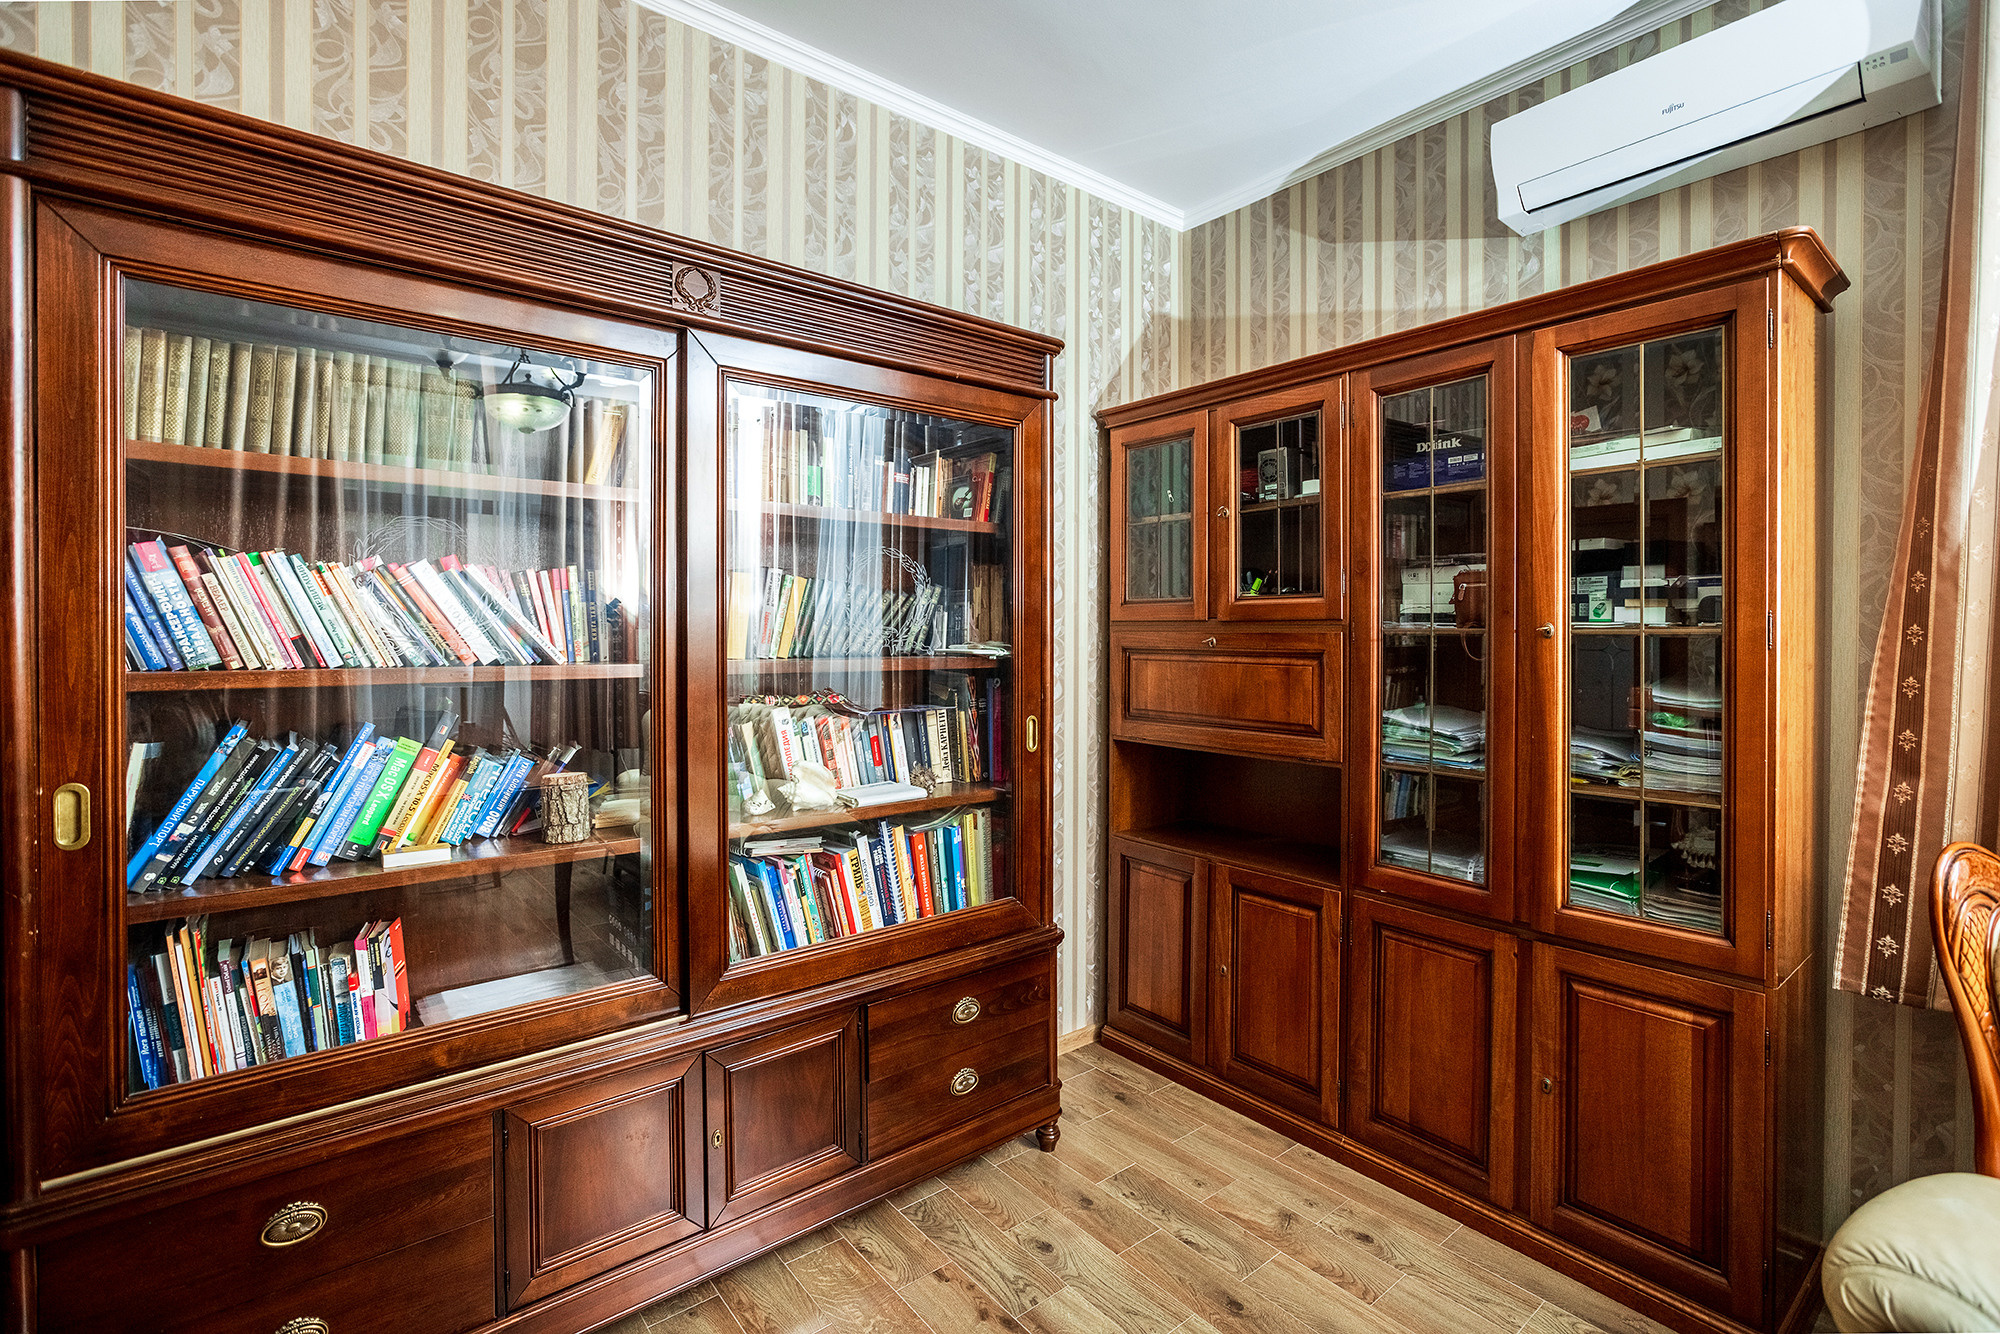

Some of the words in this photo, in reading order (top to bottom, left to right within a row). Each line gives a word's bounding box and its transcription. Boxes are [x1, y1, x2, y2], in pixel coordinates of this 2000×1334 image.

[1661, 102, 1685, 115] FUJITSU
[208, 582, 229, 613] ВЕЛЛЕР
[295, 562, 326, 612] МЕДИТАЦИЯ
[164, 577, 209, 655] РЕАЛЬНОСТИ
[589, 619, 598, 641] КНИГА
[573, 639, 583, 657] 2000
[936, 711, 949, 750] КАРНЕГИ
[363, 761, 377, 777] ВСЕ
[386, 754, 408, 779] Mac
[425, 761, 440, 781] Mac
[464, 753, 481, 776] English
[940, 751, 950, 771] Дейл
[359, 773, 370, 783] О
[379, 775, 397, 793] OS
[494, 776, 519, 811] АНГЛИЙСКОГО
[515, 760, 530, 778] ЯЗЫКА
[168, 777, 206, 823] ПАРУСНЫЙ
[339, 780, 366, 818] ПАРУСНОМ
[375, 789, 390, 802] X
[407, 796, 420, 812] 10.5
[359, 797, 381, 826] Leopard
[392, 810, 412, 837] Leopard
[479, 808, 500, 834] 8000
[147, 818, 175, 850] СПОРТ
[323, 815, 346, 845] СПОРТЕ
[848, 855, 864, 889] ГРИЛЬ
[860, 857, 870, 881] РАМЗИ
[864, 880, 874, 906] ГОРДОН
[134, 1009, 147, 1037] пальцев
[138, 1038, 150, 1055] Йога
